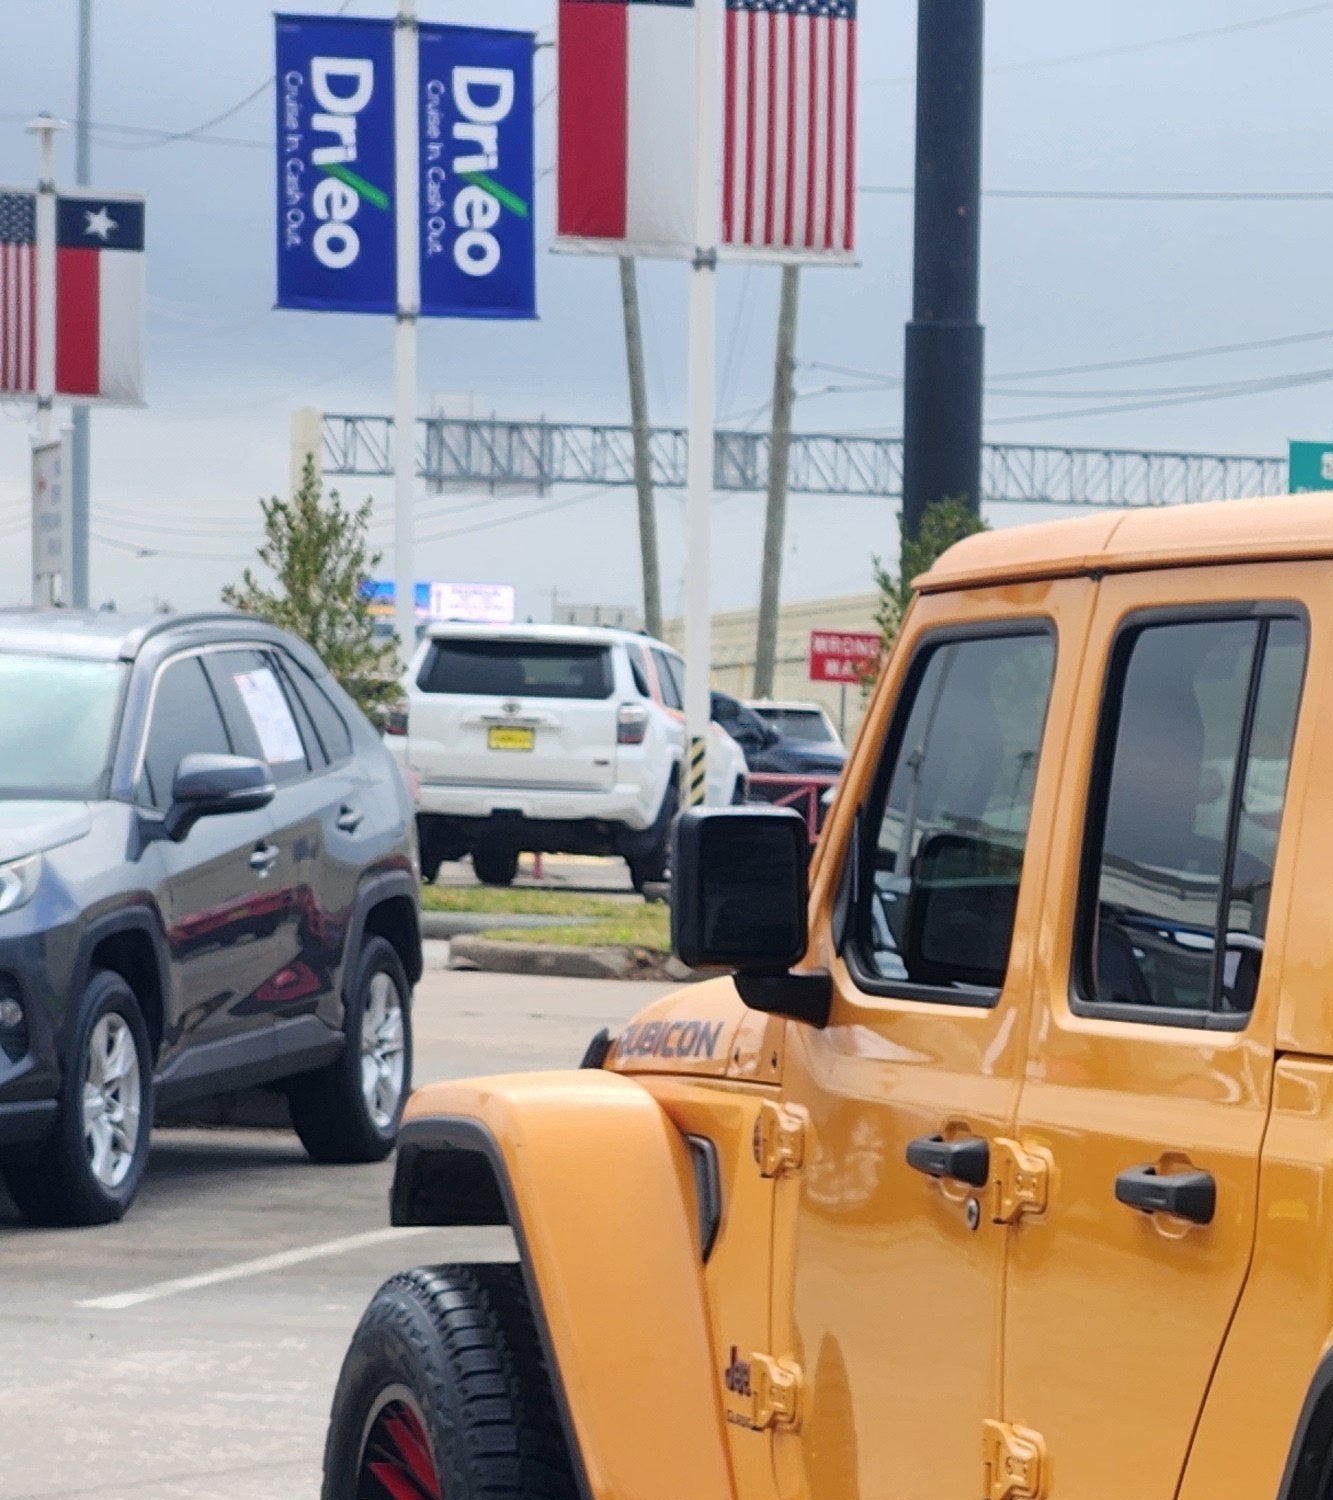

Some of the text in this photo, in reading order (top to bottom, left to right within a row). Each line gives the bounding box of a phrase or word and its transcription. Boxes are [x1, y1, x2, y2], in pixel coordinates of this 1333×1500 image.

[285, 70, 304, 130] Cruise
[427, 79, 445, 138] Cruise
[286, 157, 304, 206] Cash
[427, 166, 446, 214] Cash
